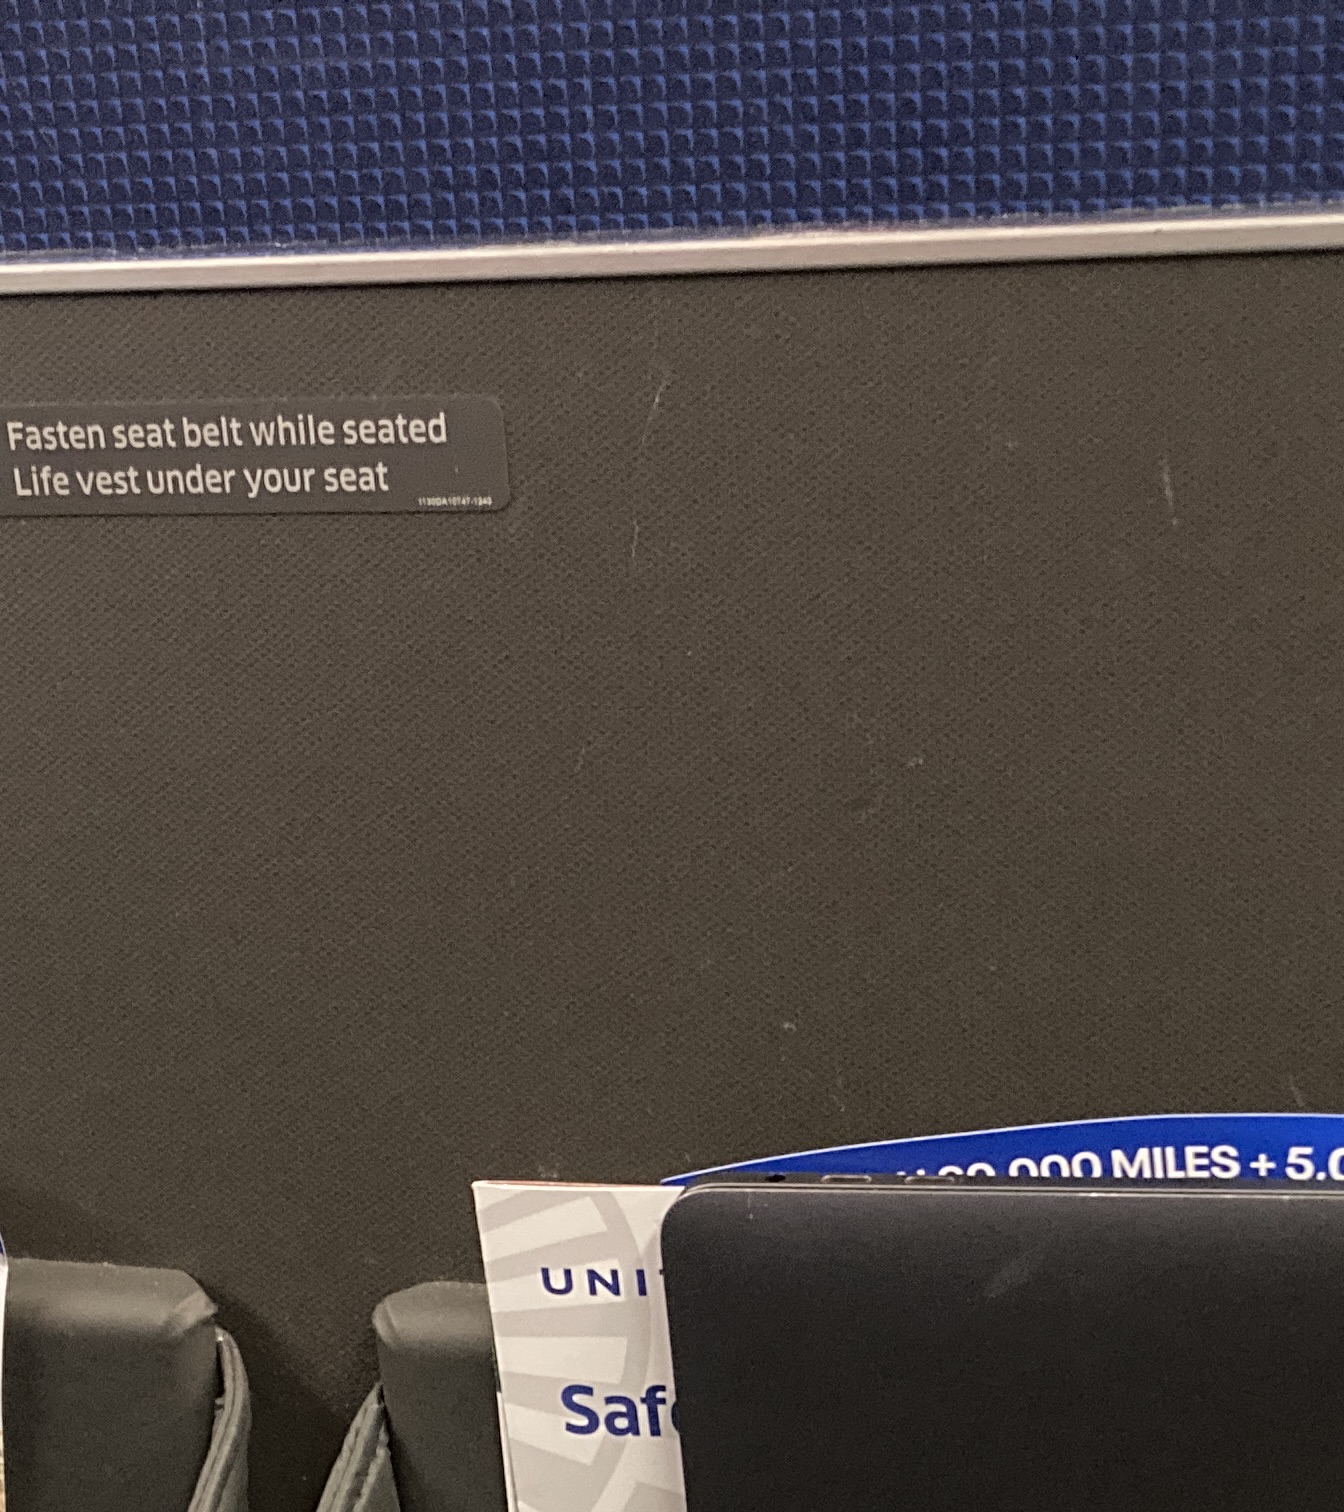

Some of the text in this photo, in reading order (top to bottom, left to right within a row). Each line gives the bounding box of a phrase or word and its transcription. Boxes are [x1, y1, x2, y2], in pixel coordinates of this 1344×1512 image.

[7, 411, 447, 451] Fasten seat belt while seated
[13, 461, 389, 499] Life vest under your seat
[1111, 1144, 1242, 1180] MILES
[540, 1266, 664, 1298] UNI
[560, 1384, 682, 1437] Saf
